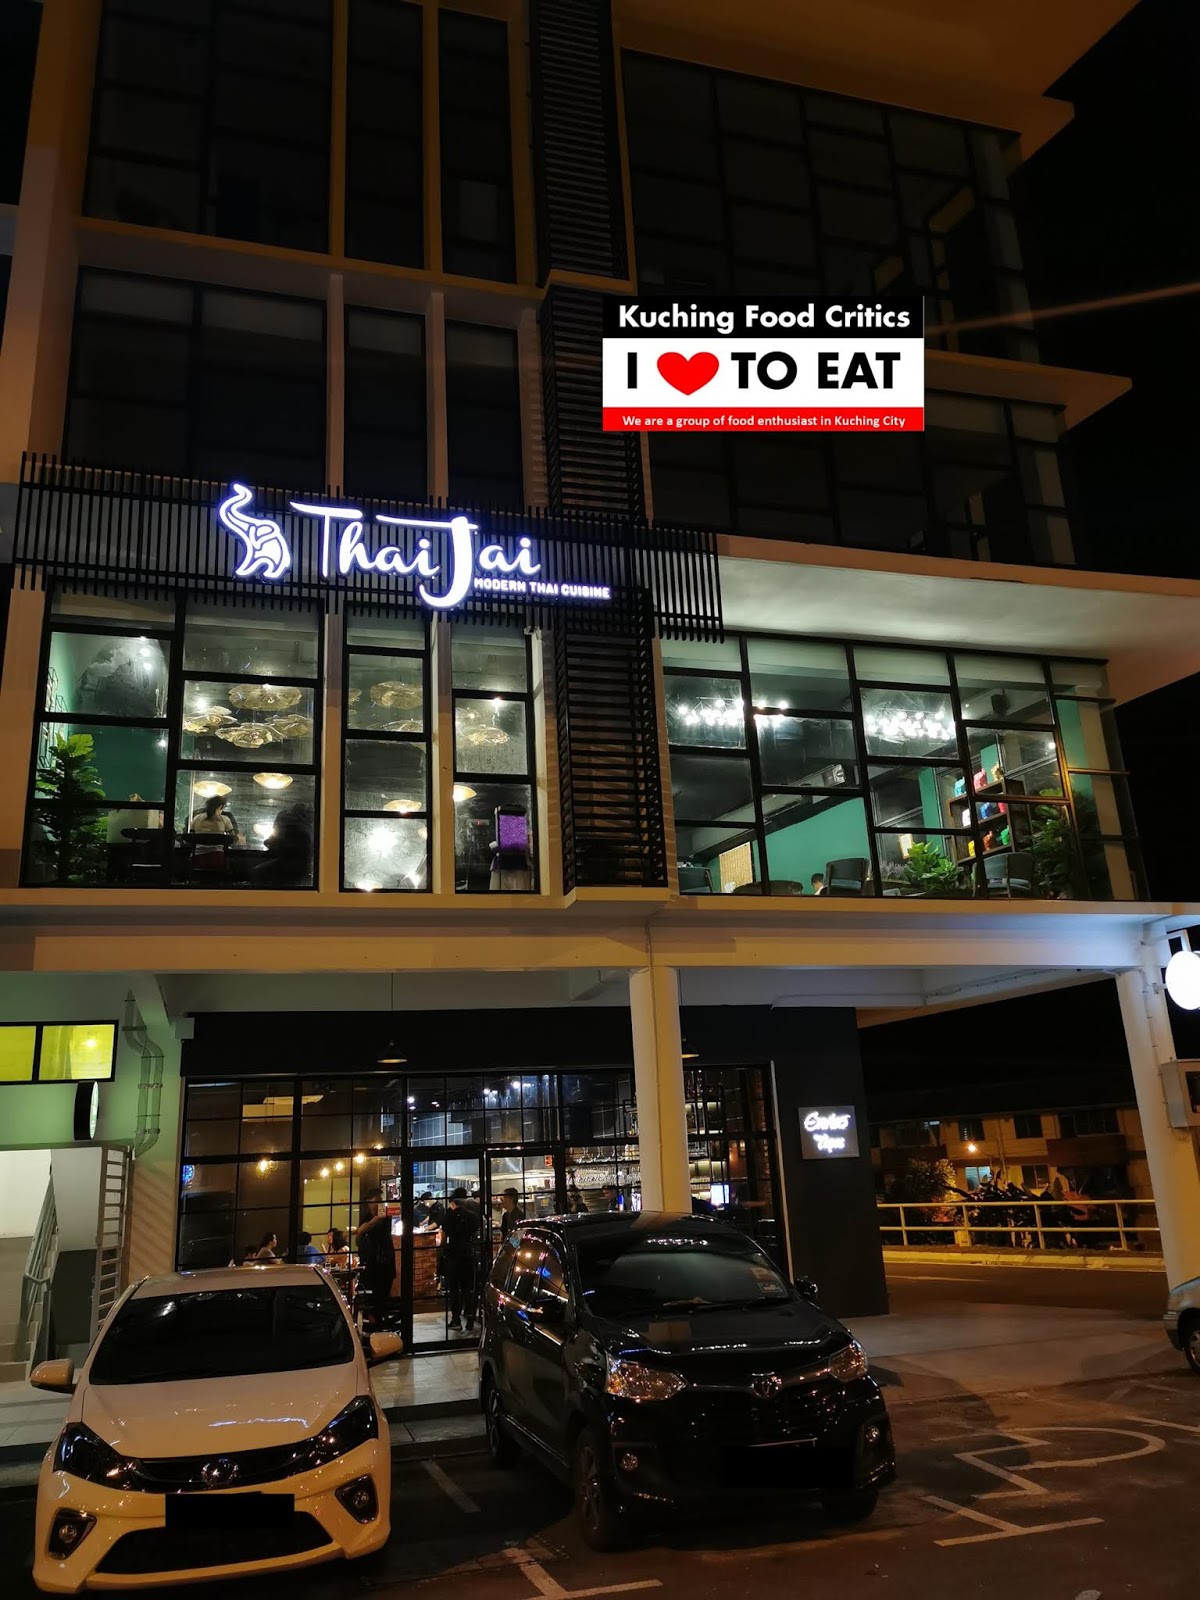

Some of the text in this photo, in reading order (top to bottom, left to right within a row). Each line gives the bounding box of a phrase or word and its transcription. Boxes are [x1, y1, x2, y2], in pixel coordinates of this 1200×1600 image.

[289, 501, 542, 608] Thai Jai
[473, 577, 611, 600] MODERN THAI CUISINE
